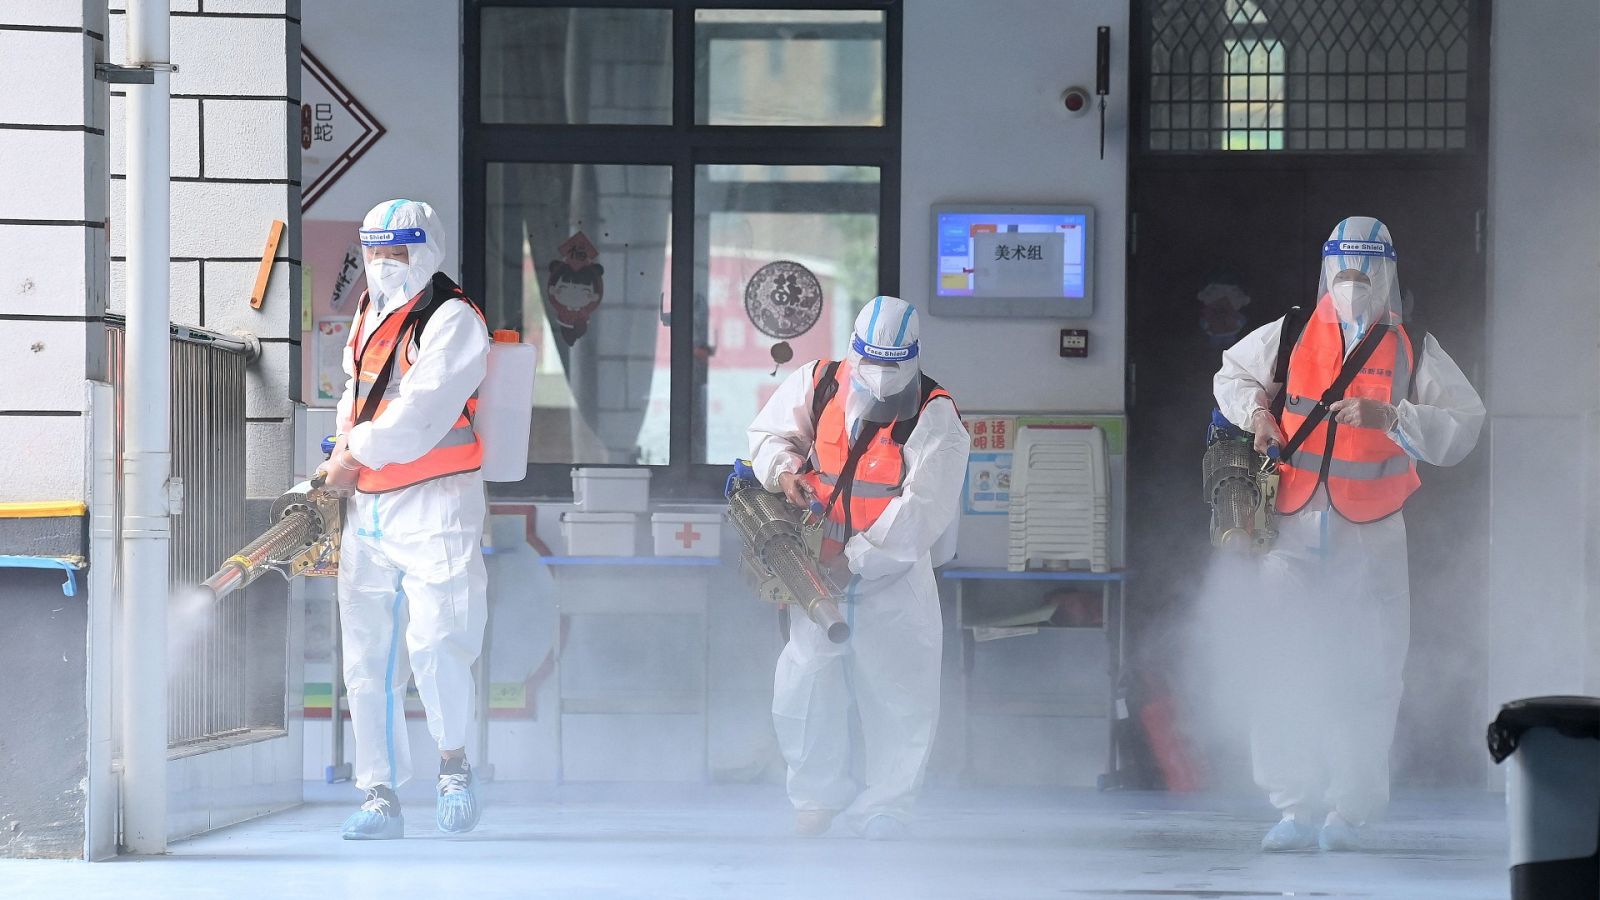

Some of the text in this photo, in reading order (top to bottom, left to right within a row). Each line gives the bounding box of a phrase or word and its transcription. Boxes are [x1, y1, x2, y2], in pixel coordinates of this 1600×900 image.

[994, 244, 1043, 261] 美术组
[1361, 243, 1383, 251] Shield
[867, 346, 882, 356] Face
[884, 350, 907, 358] Shield
